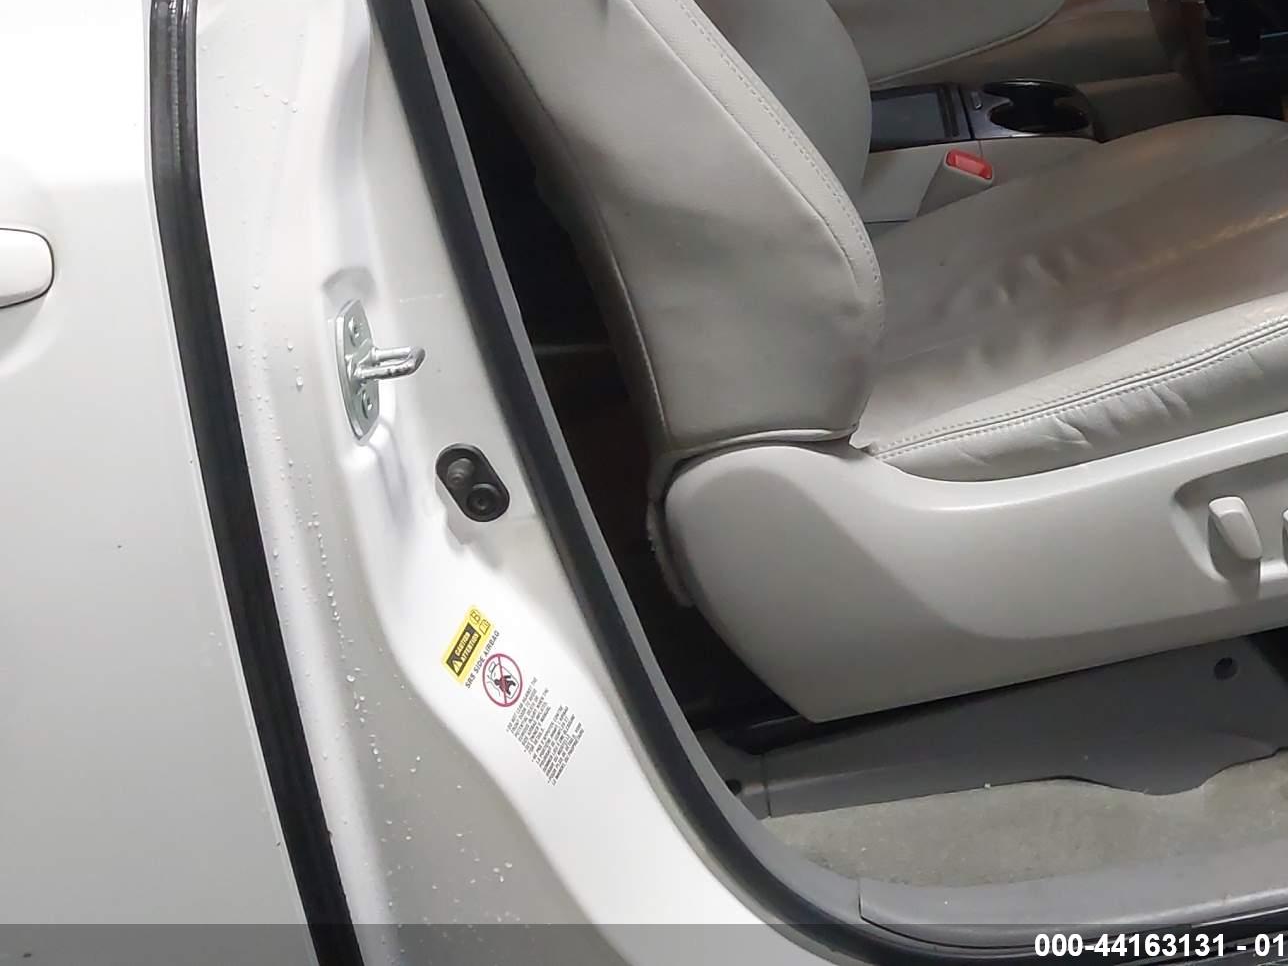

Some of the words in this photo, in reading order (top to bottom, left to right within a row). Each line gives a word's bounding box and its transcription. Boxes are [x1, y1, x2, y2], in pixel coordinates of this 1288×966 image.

[465, 672, 476, 689] SRS
[475, 656, 485, 674] SIDE
[484, 629, 500, 657] AIRBAG
